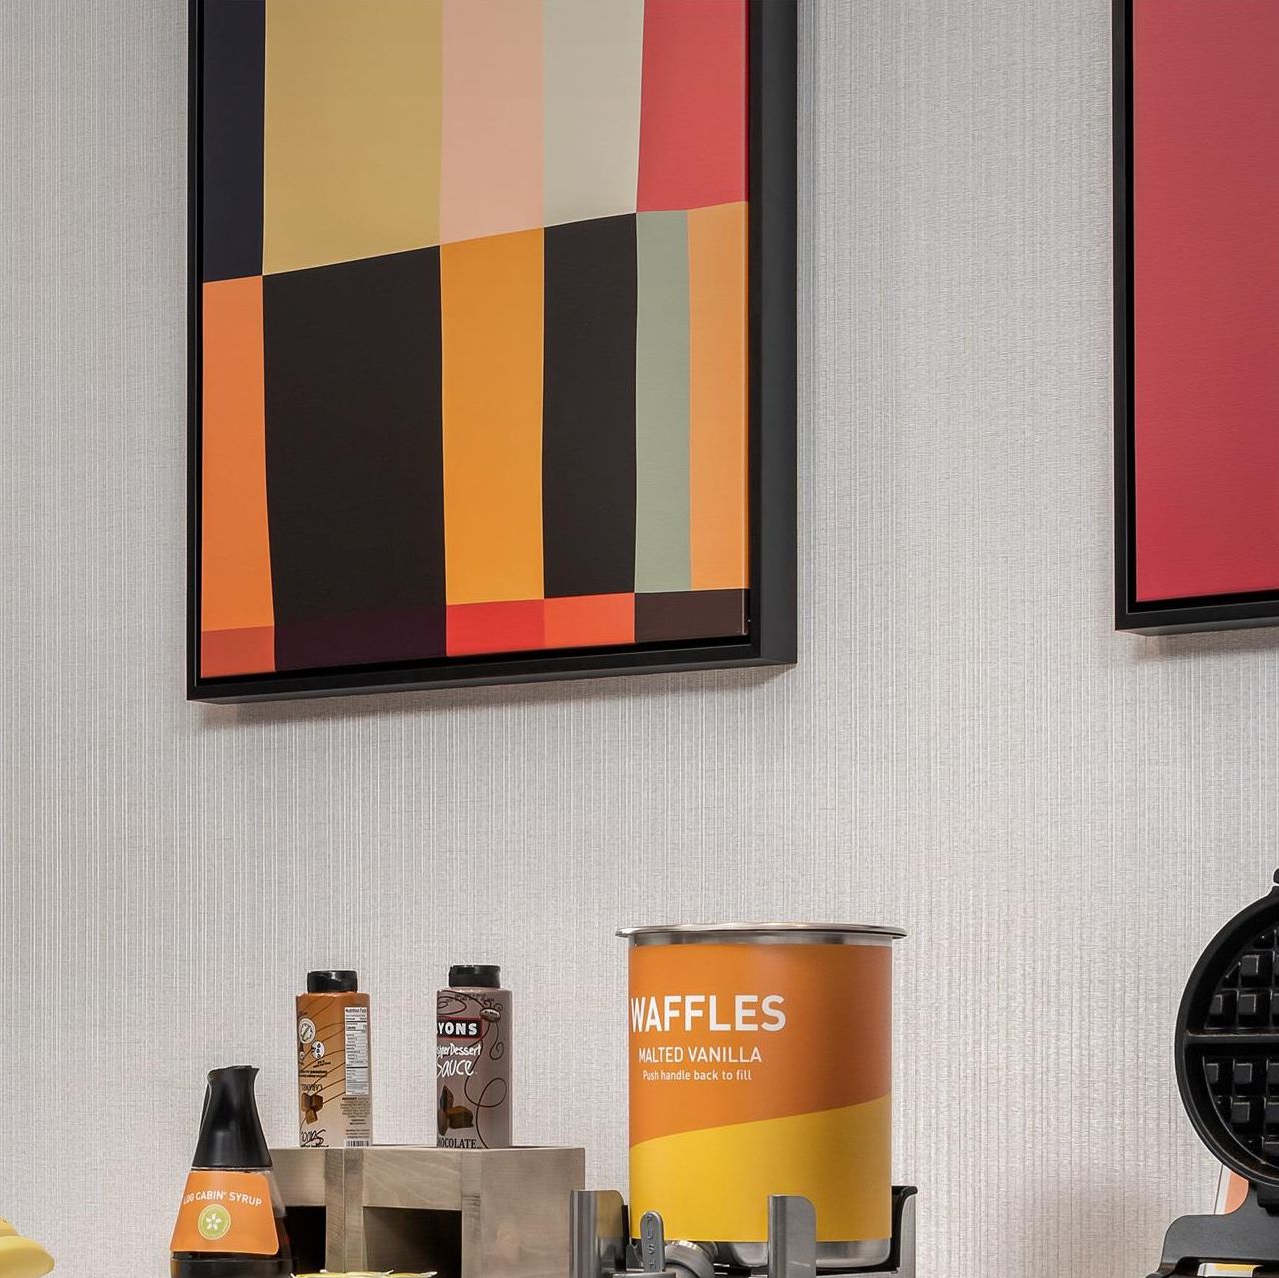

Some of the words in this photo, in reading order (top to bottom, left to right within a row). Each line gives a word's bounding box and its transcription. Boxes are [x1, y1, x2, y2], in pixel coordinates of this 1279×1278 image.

[630, 994, 786, 1033] WAFFLES
[437, 1022, 477, 1035] YONS
[450, 1043, 481, 1056] Dessert
[638, 1046, 684, 1063] MALTED
[687, 1046, 762, 1063] VANILLA
[642, 1069, 659, 1081] Push
[660, 1069, 690, 1081] handle
[693, 1069, 719, 1081] back
[722, 1070, 733, 1081] to
[736, 1069, 752, 1081] fill
[182, 1192, 195, 1205] LOG
[228, 1191, 263, 1207] SYRUP
